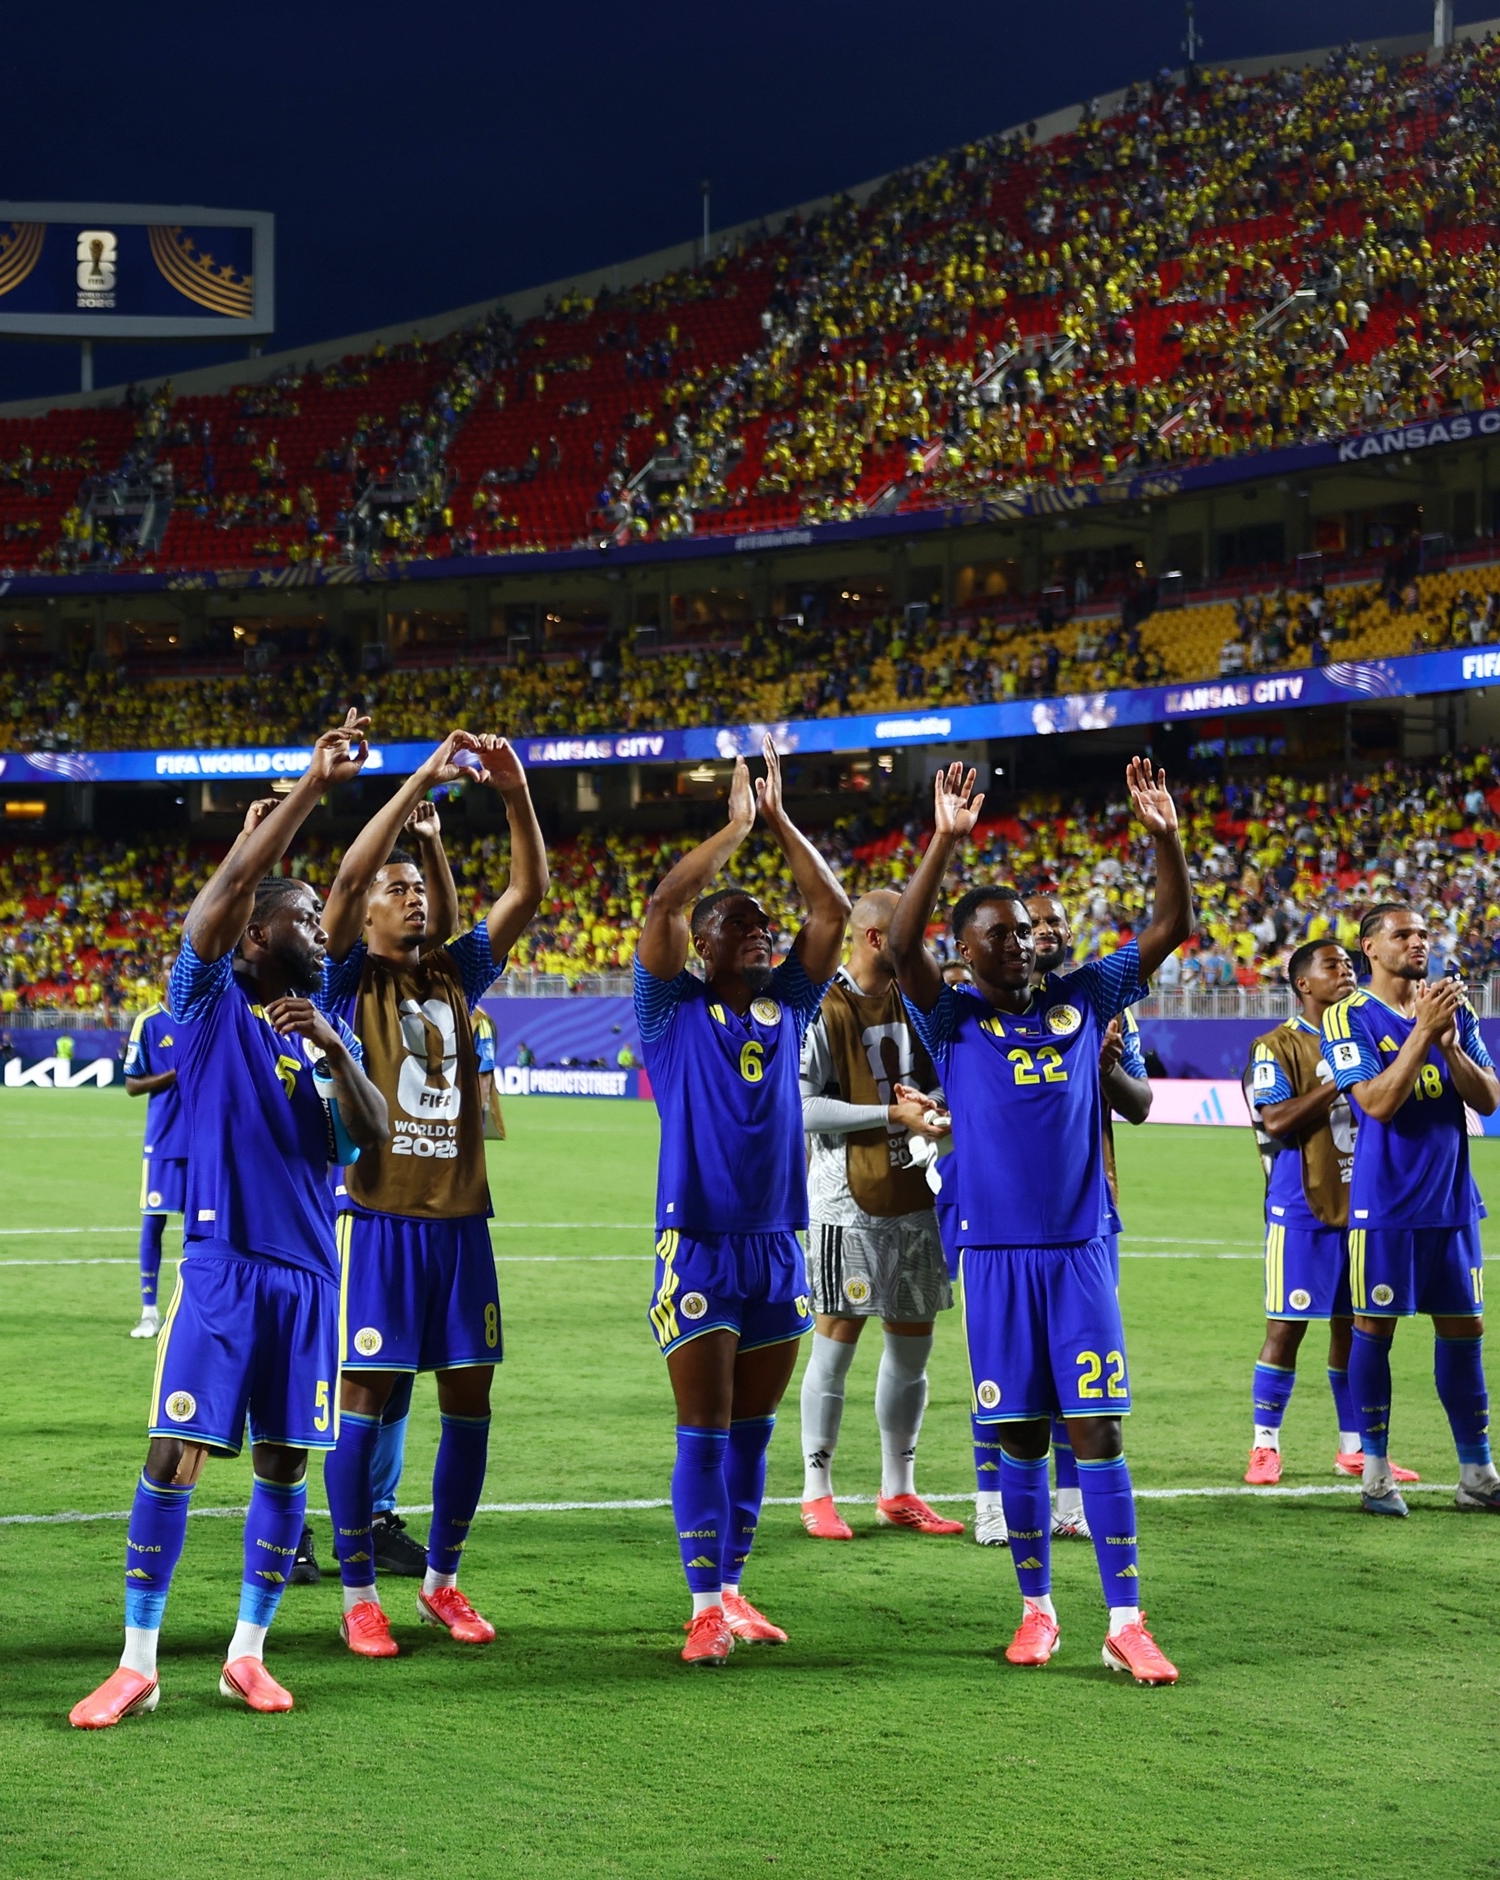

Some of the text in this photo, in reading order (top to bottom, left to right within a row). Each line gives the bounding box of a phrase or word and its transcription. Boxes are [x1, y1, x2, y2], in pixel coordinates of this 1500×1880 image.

[77, 299, 115, 308] 2026
[1338, 416, 1473, 462] KANSAS
[1165, 676, 1303, 713] KANSAS CITY
[156, 755, 199, 774] FIFA
[199, 753, 270, 774] WORLD
[271, 751, 313, 772] CUP
[529, 736, 664, 761] KANSAS CITY
[275, 1055, 301, 1099] 5
[740, 1041, 764, 1082] 6
[1007, 1046, 1068, 1085] 22
[530, 1069, 629, 1096] PREDICTSTREET
[1414, 1063, 1443, 1101] 18
[392, 1136, 458, 1158] 2026
[394, 1120, 447, 1137] WORLD
[484, 1303, 498, 1349] 8
[1076, 1350, 1128, 1398] 22
[314, 1381, 329, 1432] 5
